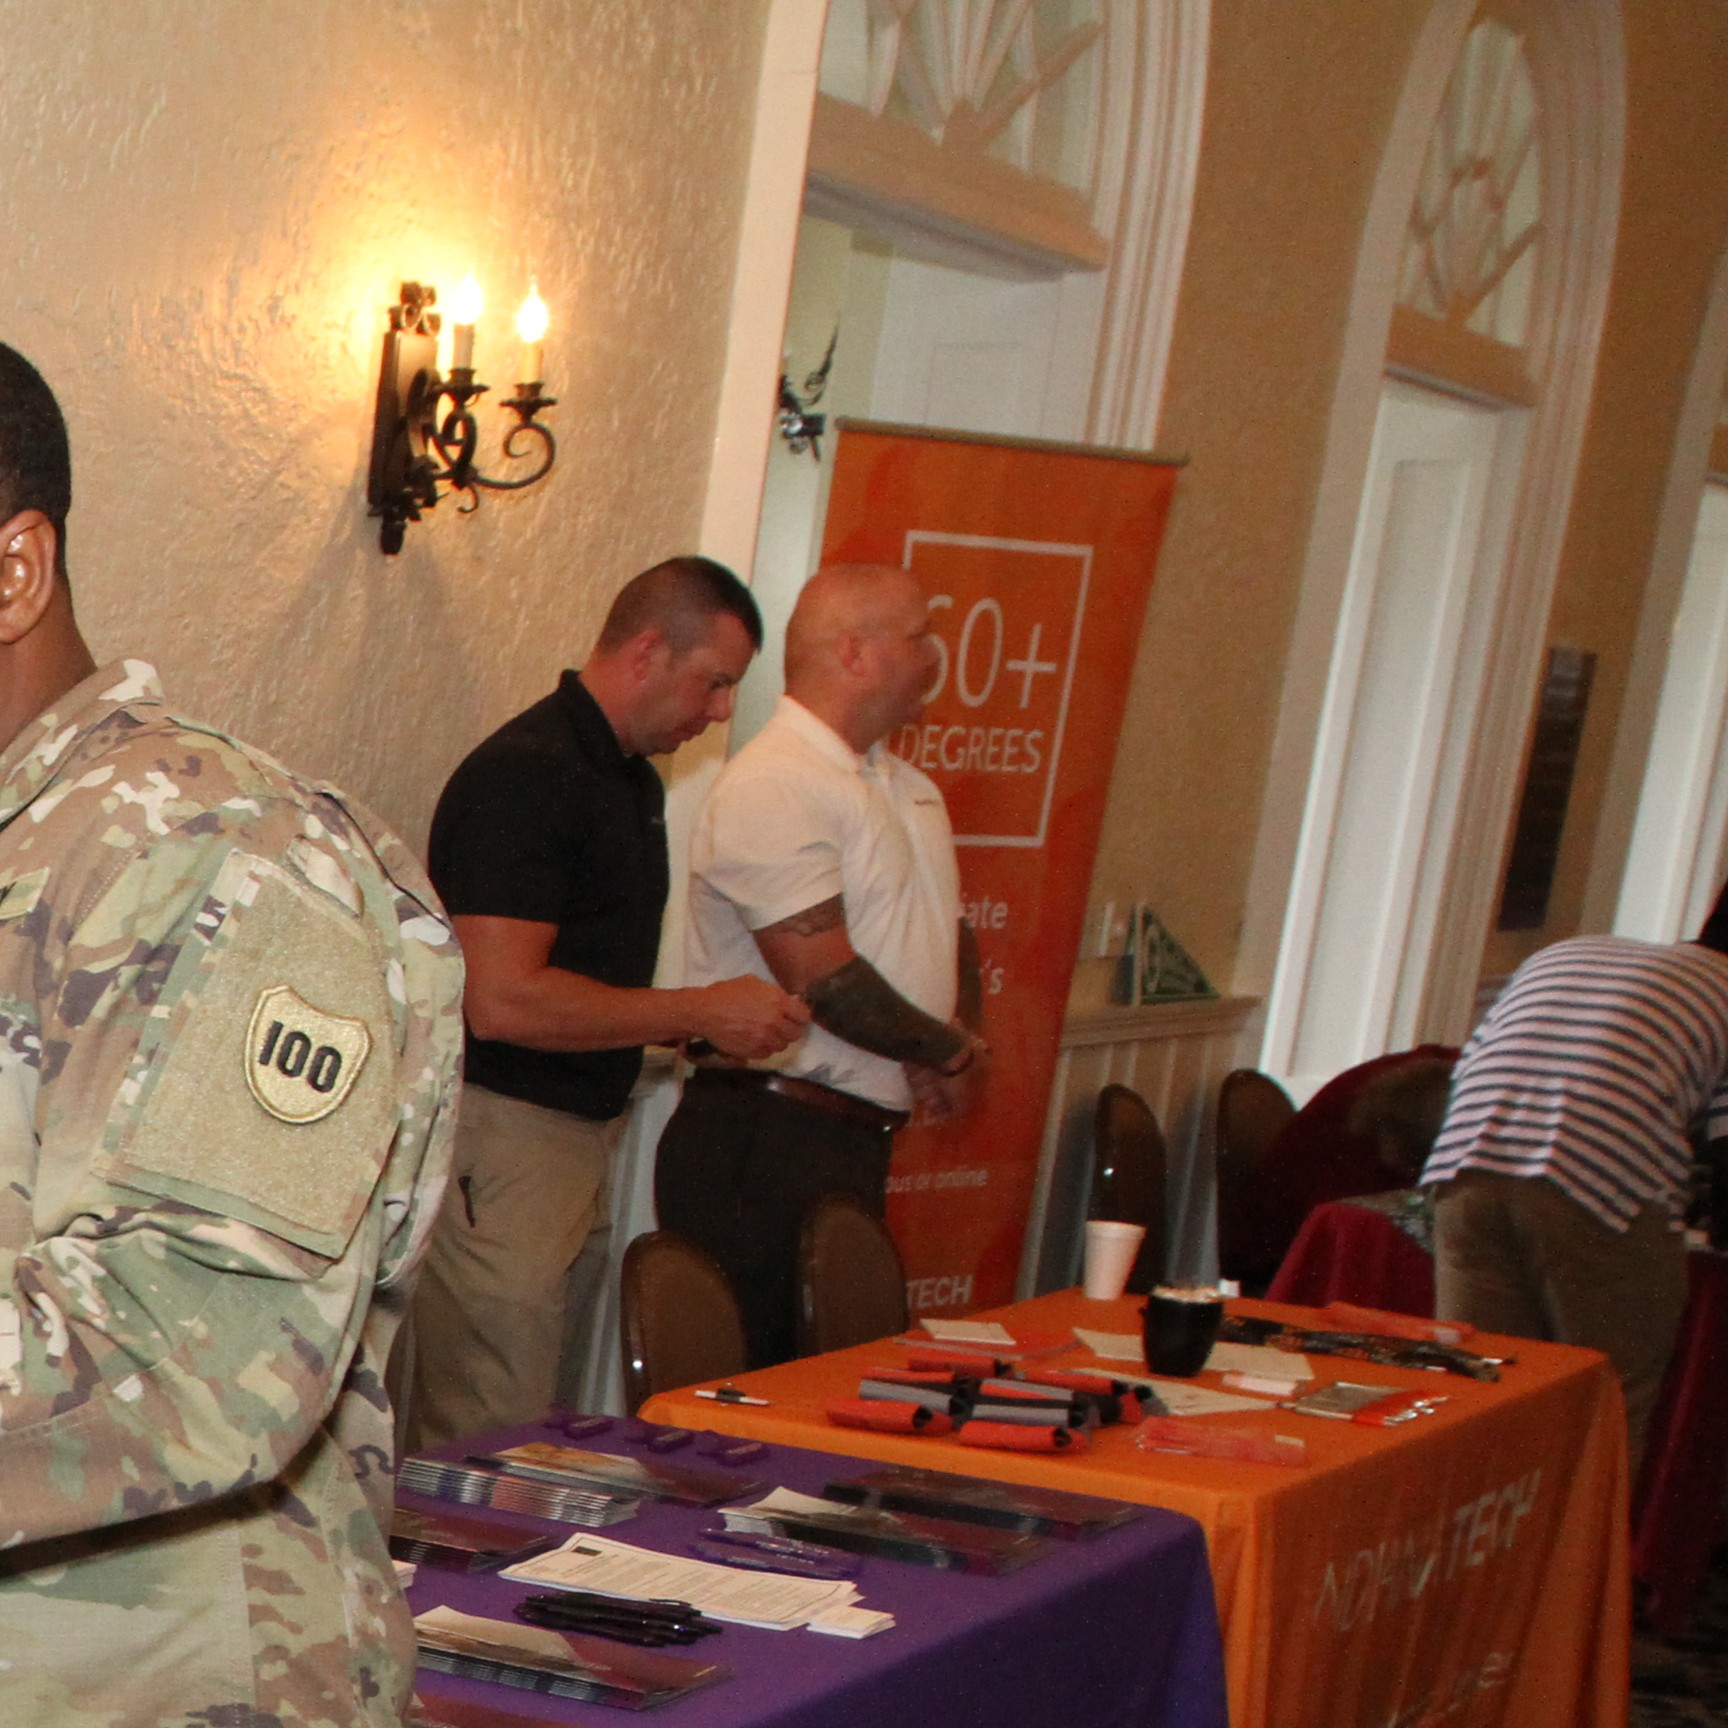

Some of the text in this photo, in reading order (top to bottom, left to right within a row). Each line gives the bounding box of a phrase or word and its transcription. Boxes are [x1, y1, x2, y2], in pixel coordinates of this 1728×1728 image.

[898, 724, 1045, 774] DEGREES
[258, 1020, 343, 1093] 100
[906, 1274, 974, 1309] TECH
